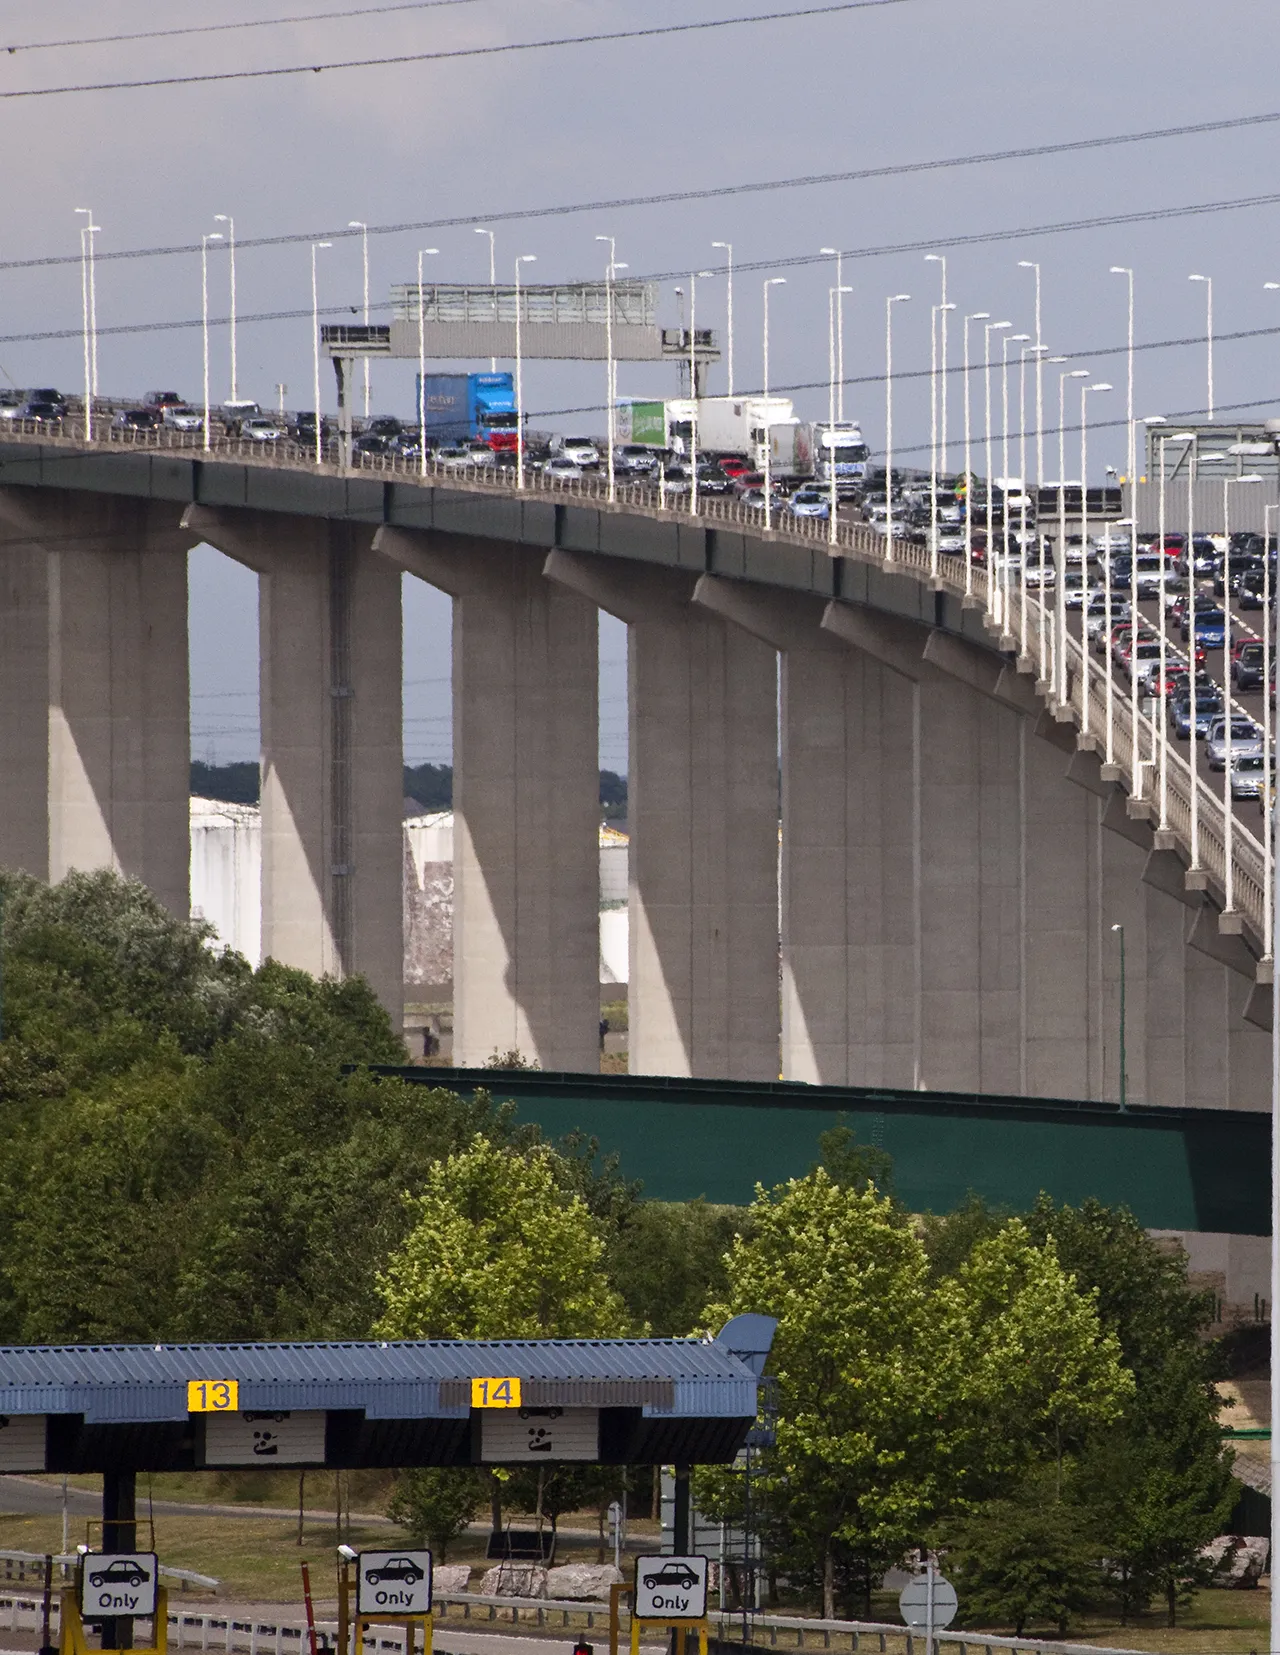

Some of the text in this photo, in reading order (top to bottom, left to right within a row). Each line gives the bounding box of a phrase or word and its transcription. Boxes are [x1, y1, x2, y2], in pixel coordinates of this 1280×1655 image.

[197, 1383, 231, 1409] 13
[477, 1380, 513, 1406] 14
[99, 1592, 140, 1609] Only
[375, 1590, 414, 1606] Only
[651, 1595, 690, 1612] Only
